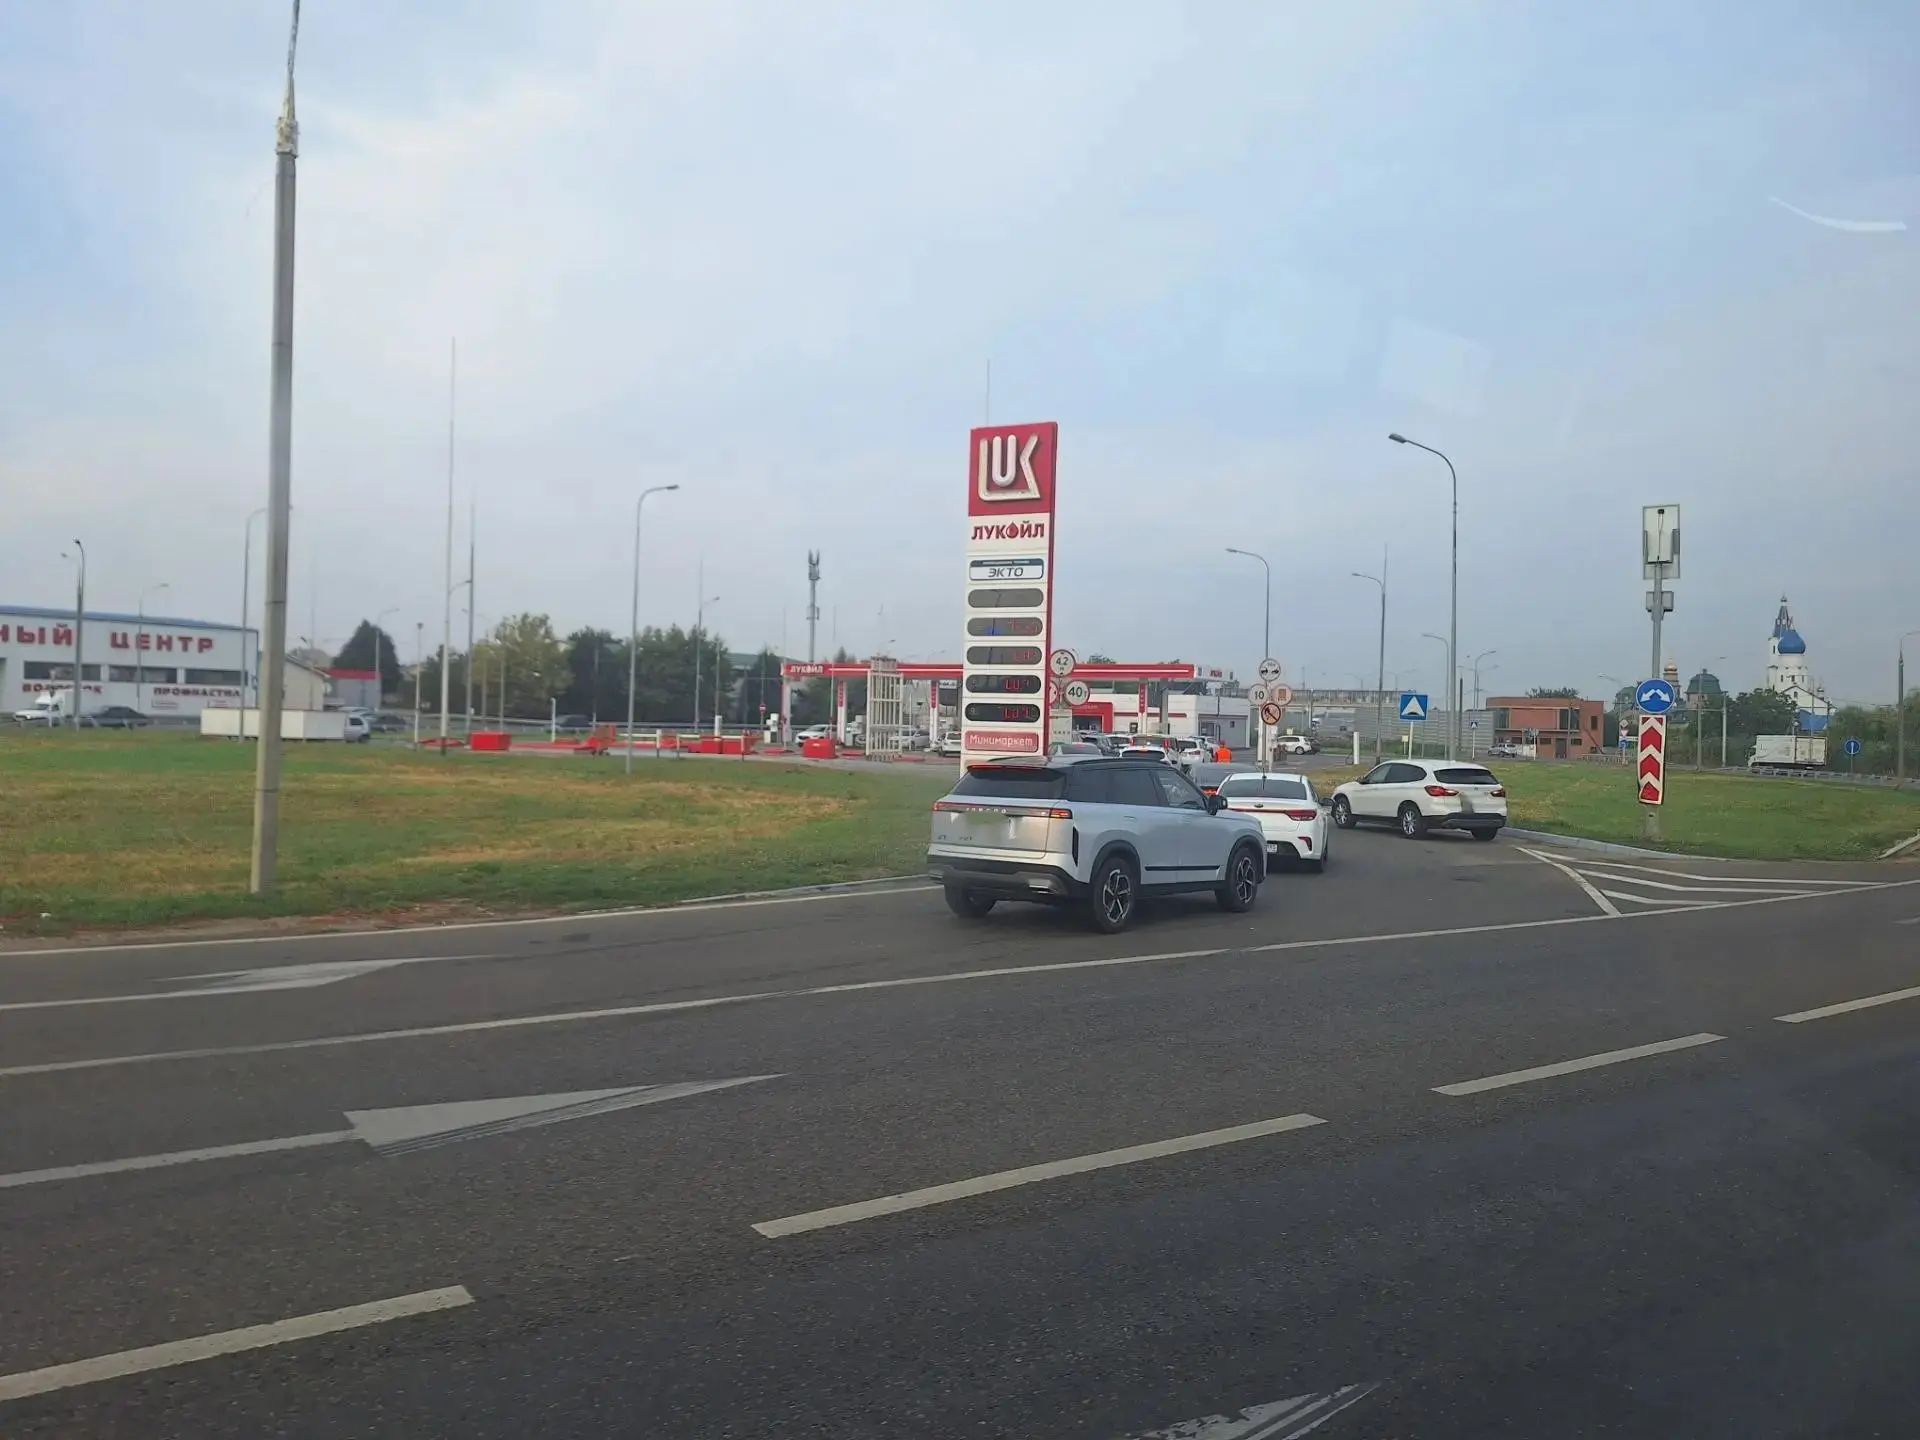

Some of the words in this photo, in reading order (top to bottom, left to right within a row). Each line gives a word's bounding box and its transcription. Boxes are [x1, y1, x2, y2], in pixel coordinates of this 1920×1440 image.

[971, 520, 1045, 540] ЛУКОЙЛ
[988, 567, 1024, 578] ЭКТО
[110, 632, 214, 653] ЦЕНТР
[1068, 686, 1083, 698] 40
[969, 733, 1033, 747] Минимаркет
